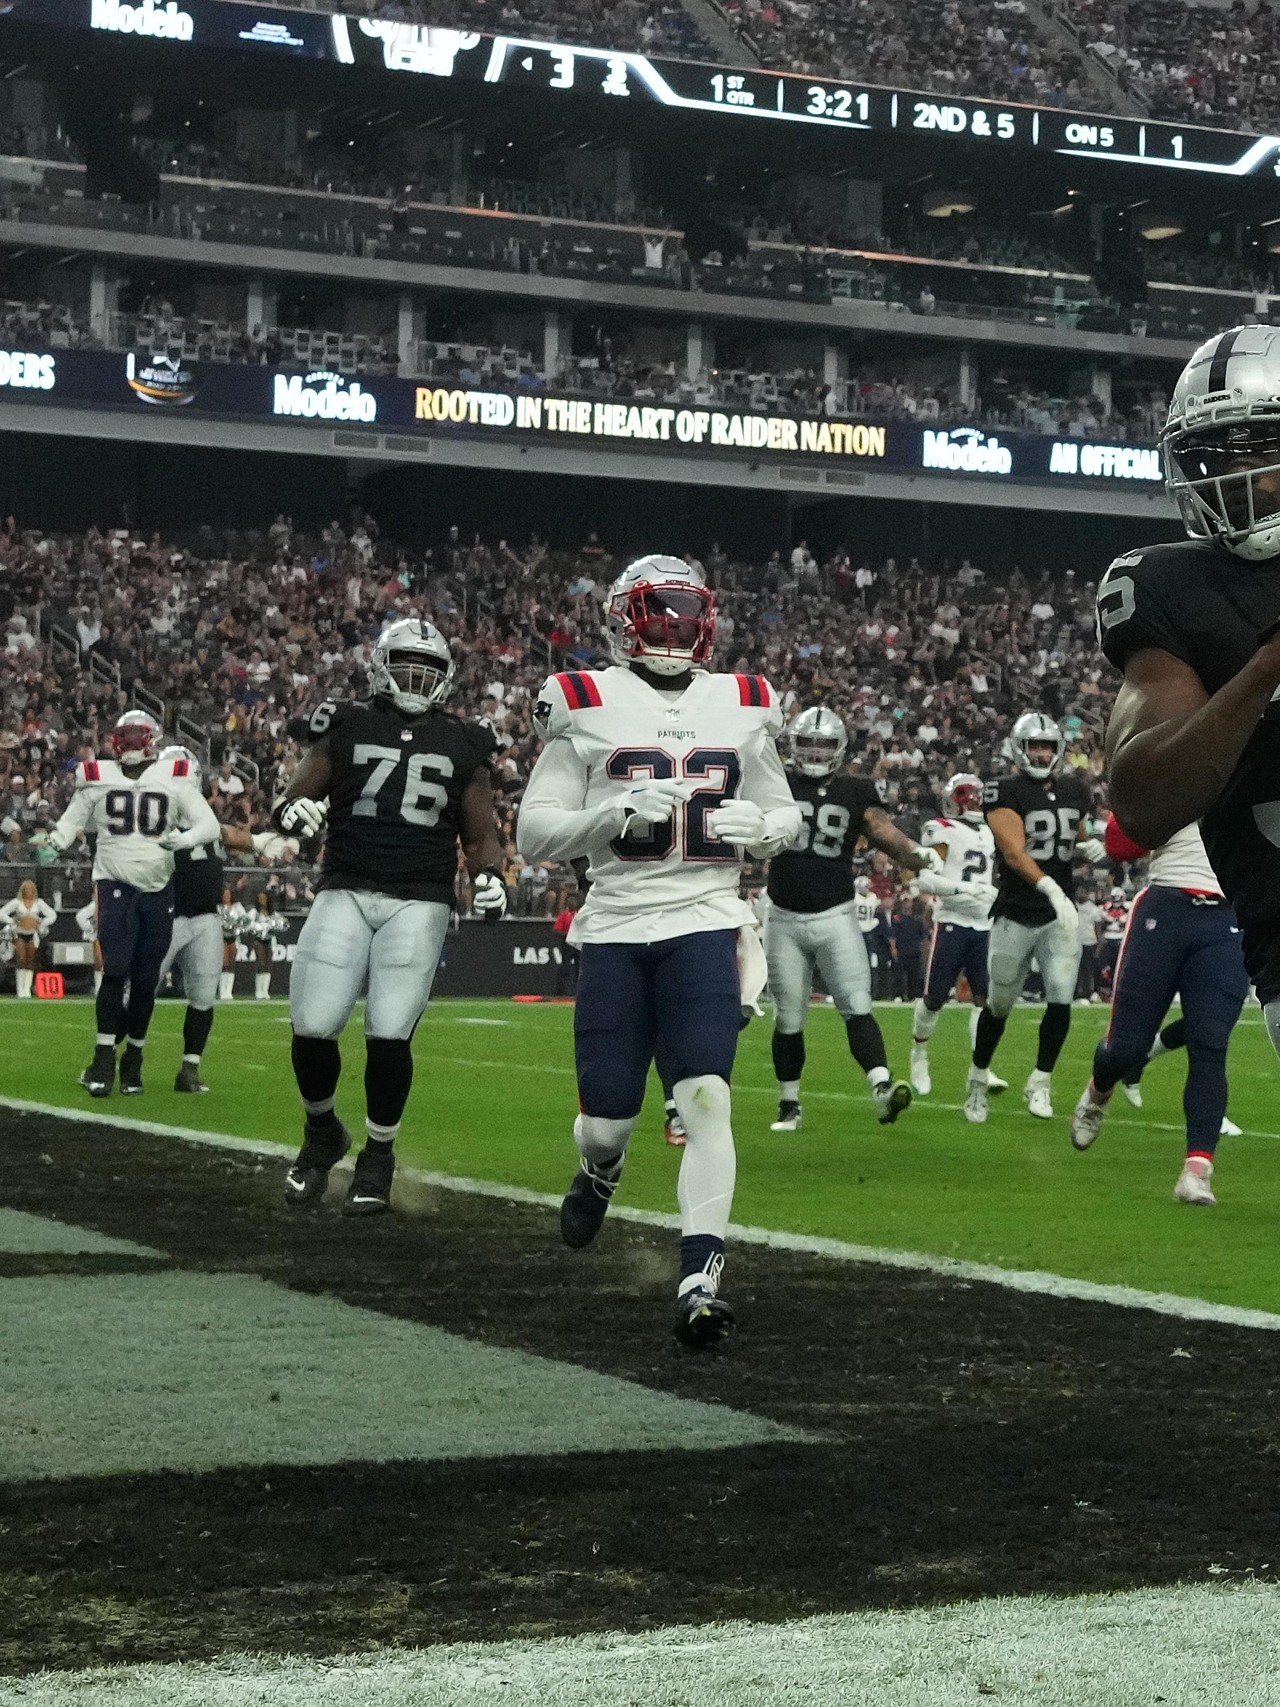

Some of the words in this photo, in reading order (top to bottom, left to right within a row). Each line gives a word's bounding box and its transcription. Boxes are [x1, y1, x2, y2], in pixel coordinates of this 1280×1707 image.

[90, 0, 194, 41] Modelo
[806, 86, 869, 119] 3:21
[913, 103, 967, 132] 2ND
[971, 111, 991, 136] &
[998, 114, 1014, 138] 5
[1065, 123, 1098, 145] ON
[1100, 127, 1114, 147] 5
[1171, 136, 1183, 159] 1
[273, 373, 377, 422] Modelo
[1203, 393, 1231, 405] RAIDERS
[416, 388, 514, 426] ROOTED
[516, 396, 542, 428] IN
[544, 399, 591, 433] THE
[594, 403, 675, 440] HEART
[674, 410, 709, 442] OF
[711, 413, 798, 450] RAIDER
[801, 421, 885, 456] NATION
[922, 429, 1012, 474] Modelo
[1050, 443, 1078, 474] AN
[1080, 444, 1163, 480] OFFICIAL
[657, 730, 696, 739] PATRIOTS
[352, 743, 455, 827] 76
[105, 790, 169, 837] 90
[605, 746, 743, 863] 32
[1024, 807, 1081, 861] 85
[513, 946, 550, 965] LAS
[39, 977, 59, 994] 10
